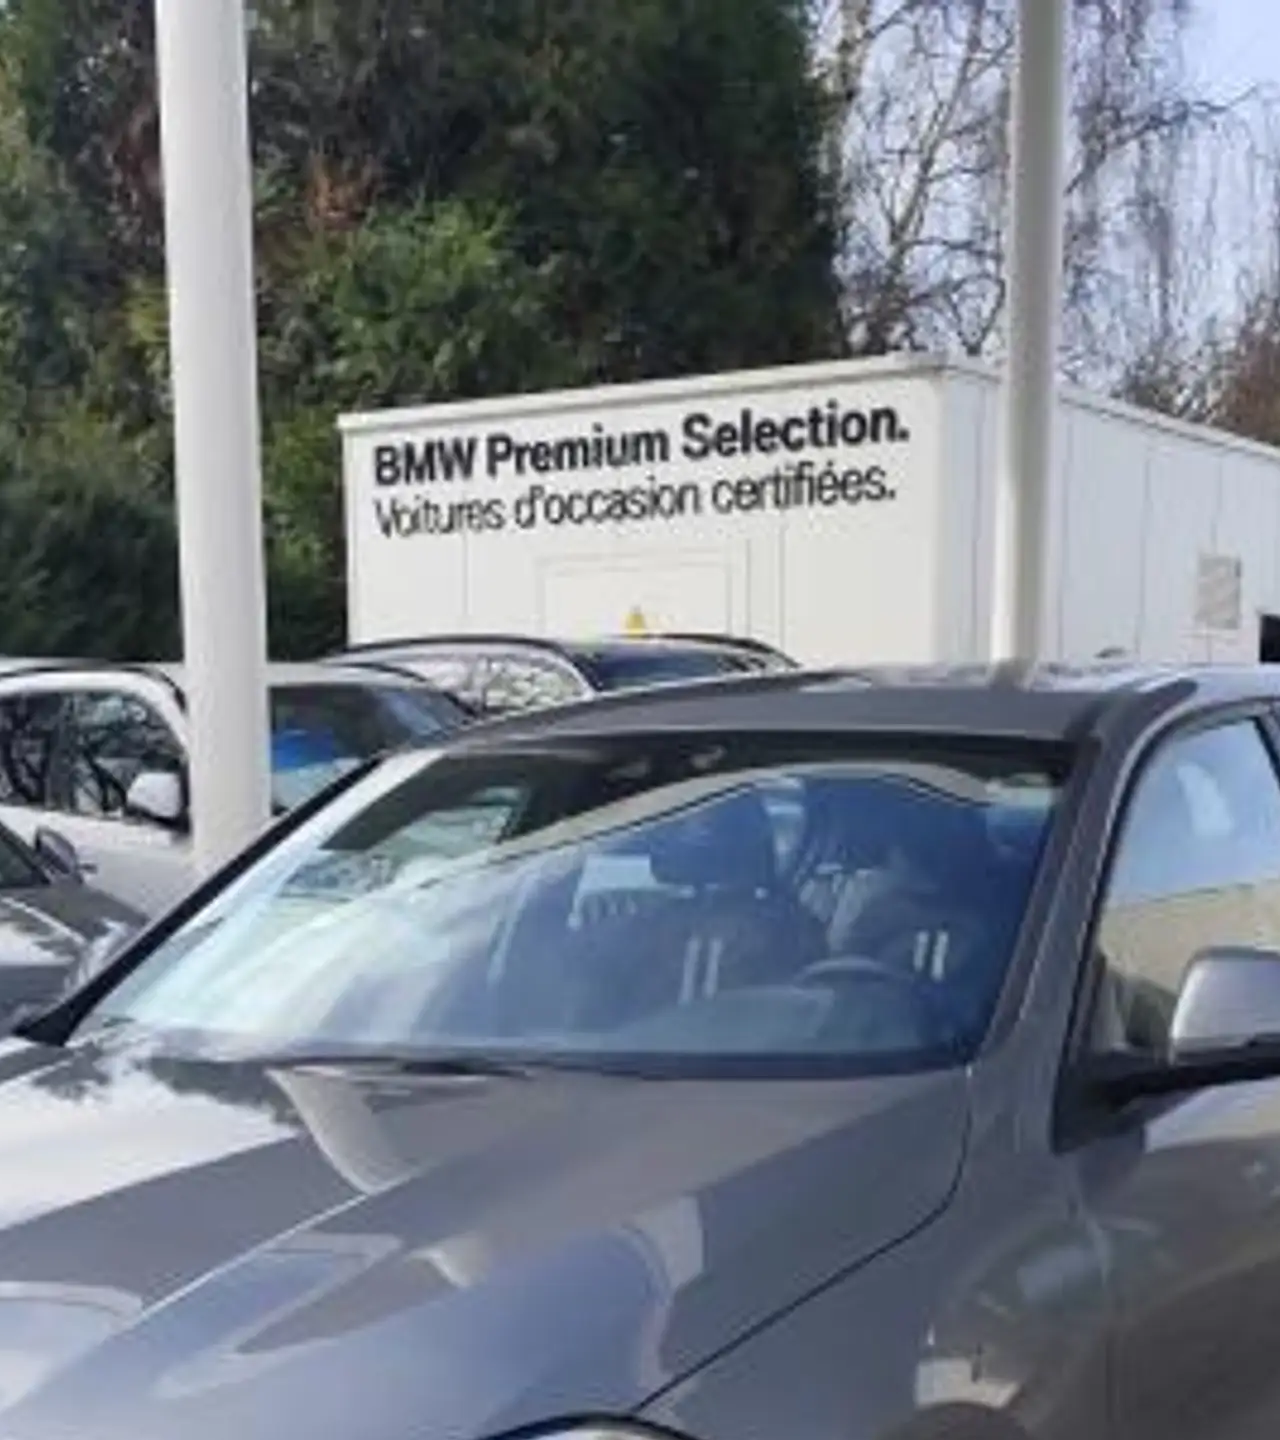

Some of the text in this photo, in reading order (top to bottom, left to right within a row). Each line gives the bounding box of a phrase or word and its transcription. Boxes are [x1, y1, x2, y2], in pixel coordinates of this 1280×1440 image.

[375, 401, 910, 486] BMW Premium Selection.
[373, 492, 504, 538] Voitures
[515, 476, 702, 528] d'occasion
